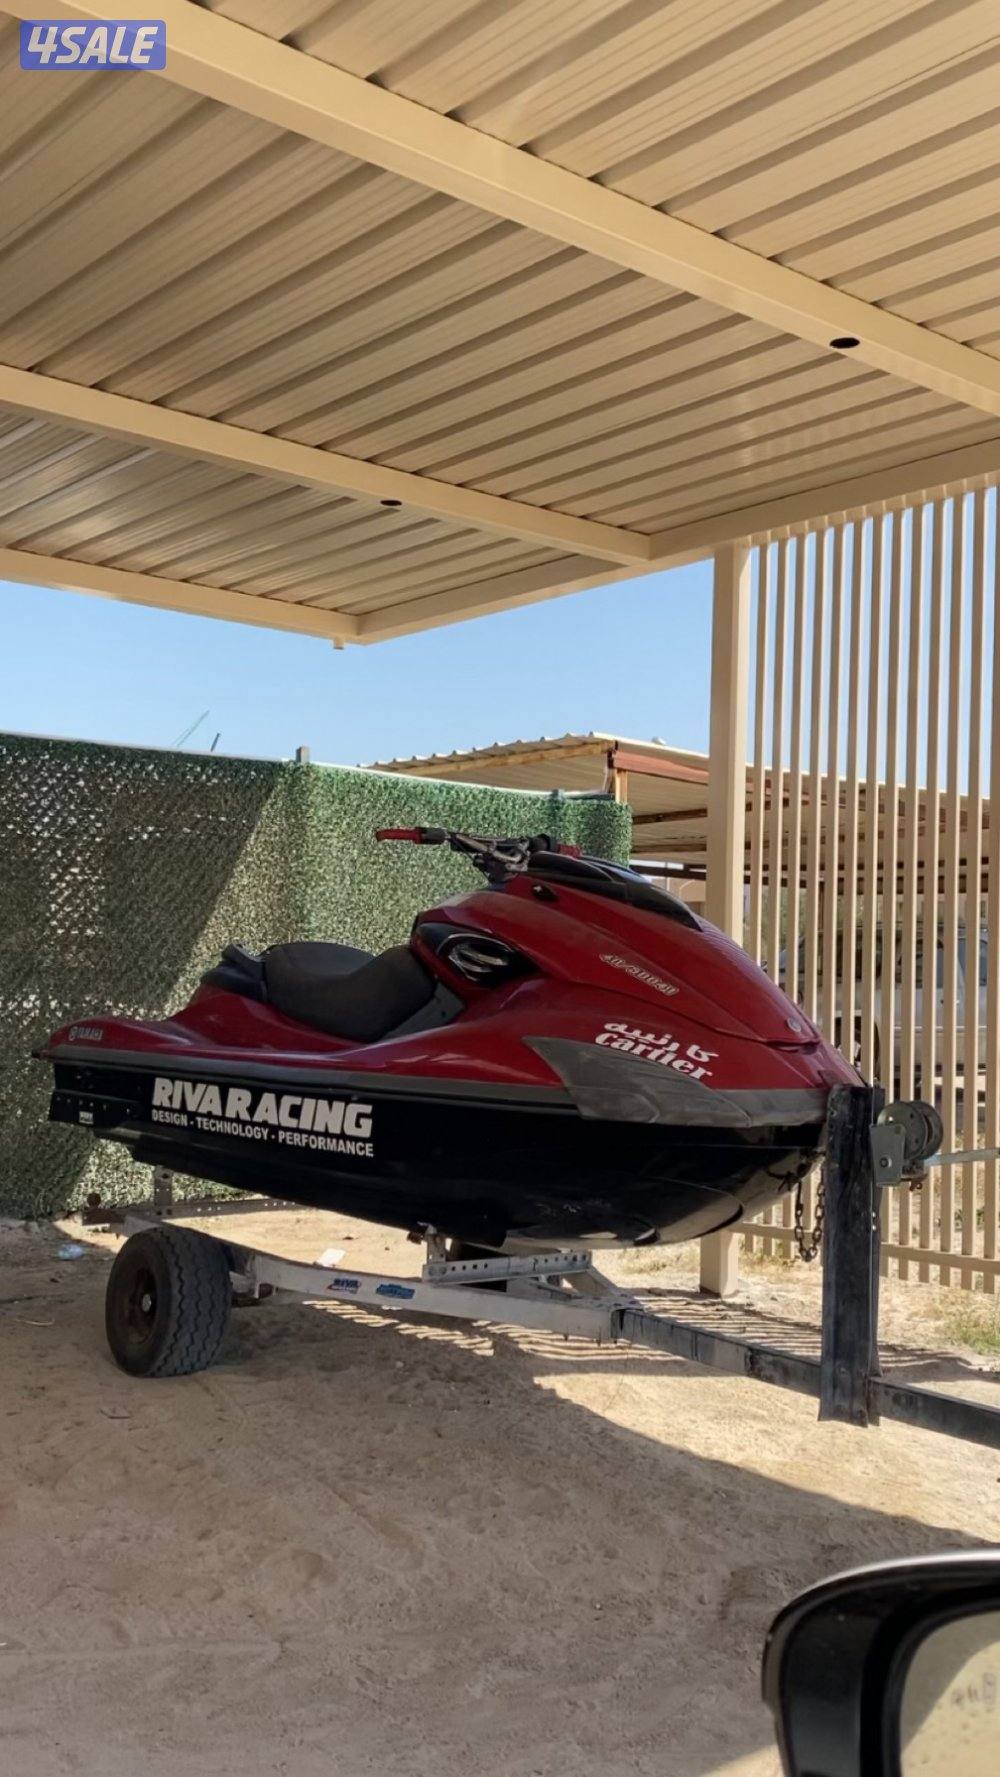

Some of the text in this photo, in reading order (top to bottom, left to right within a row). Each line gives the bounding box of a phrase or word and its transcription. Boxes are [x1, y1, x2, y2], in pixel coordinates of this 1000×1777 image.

[595, 1032, 713, 1079] Cartier
[152, 1077, 373, 1138] RIVA RACING
[152, 1109, 374, 1158] DESIGN TECHNOLOGY PERFORMANCE
